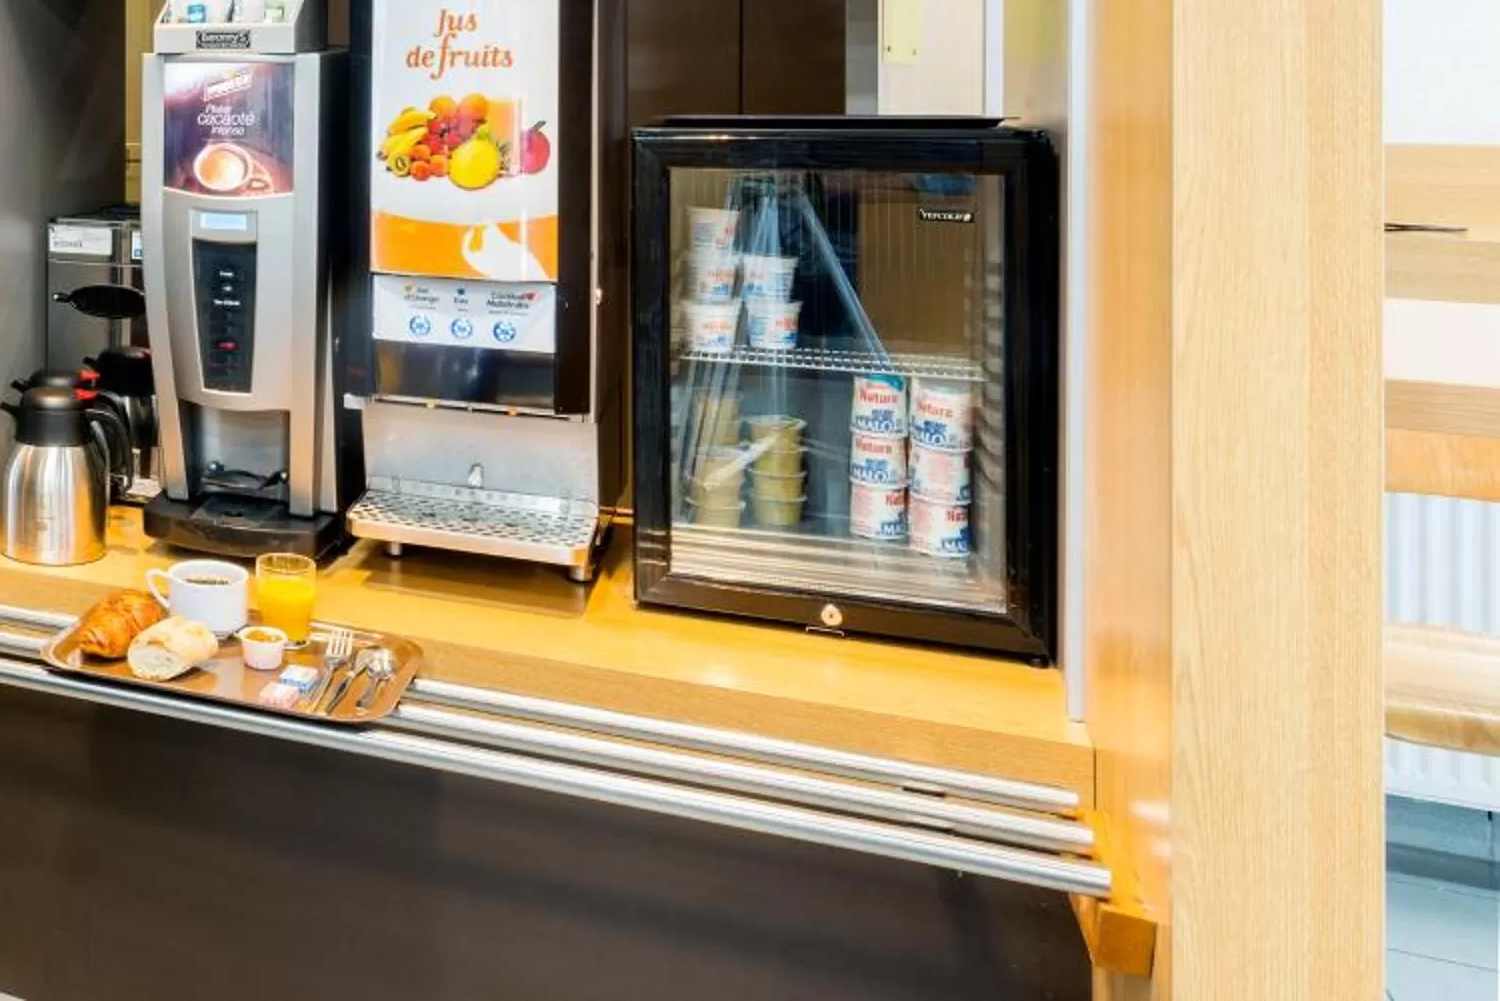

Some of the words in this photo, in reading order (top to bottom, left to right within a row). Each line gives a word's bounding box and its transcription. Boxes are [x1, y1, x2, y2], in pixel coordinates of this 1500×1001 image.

[434, 8, 479, 37] Jus
[405, 45, 435, 68] de
[429, 32, 514, 80] fruits
